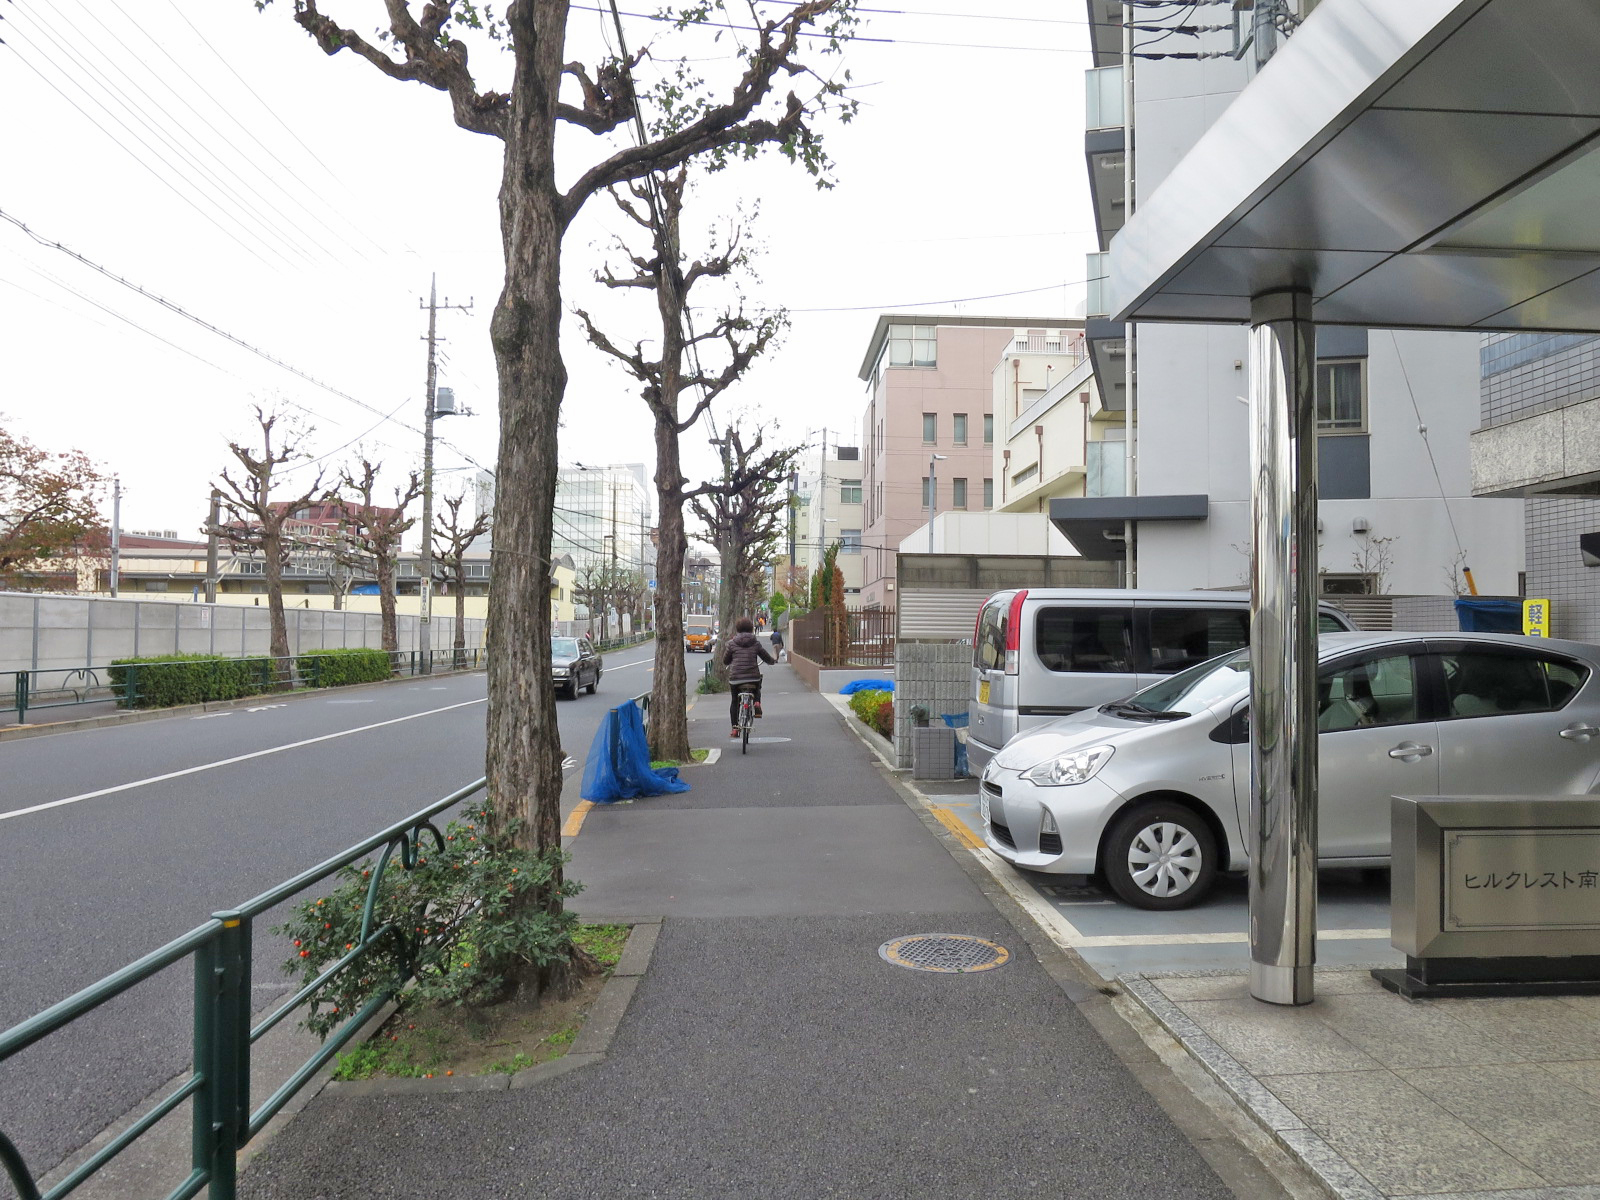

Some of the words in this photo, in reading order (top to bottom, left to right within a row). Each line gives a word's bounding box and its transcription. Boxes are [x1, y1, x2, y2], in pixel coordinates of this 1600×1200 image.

[1465, 869, 1600, 890] ヒルクレスト南
